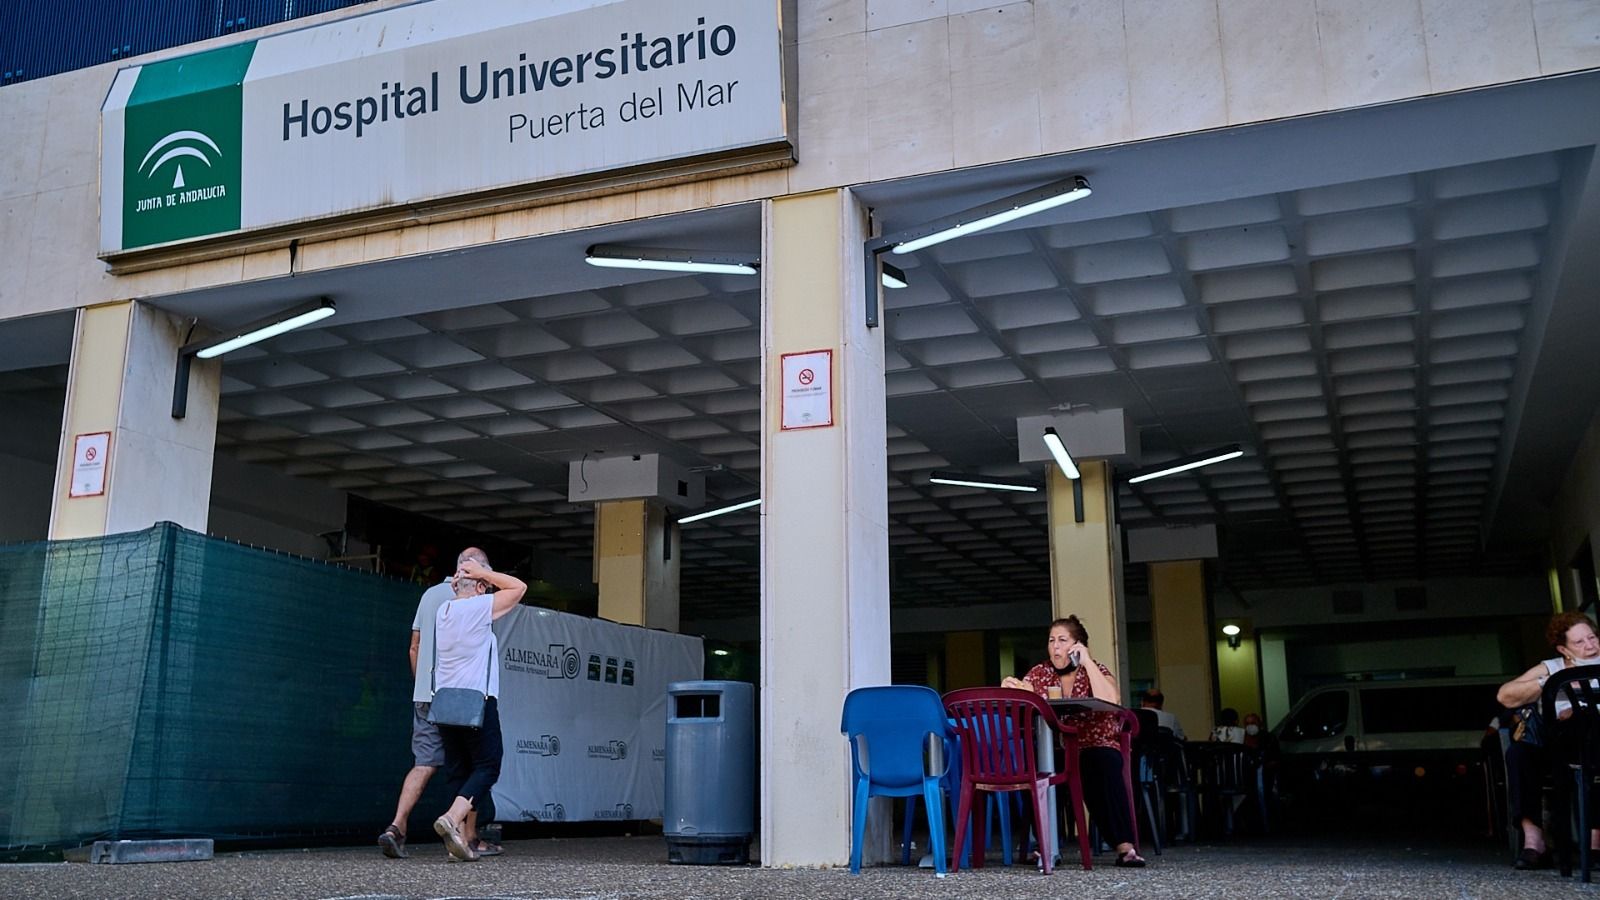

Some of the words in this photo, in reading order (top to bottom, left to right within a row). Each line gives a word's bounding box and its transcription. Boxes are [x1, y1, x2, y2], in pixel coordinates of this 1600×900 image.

[283, 72, 439, 142] Hospital
[460, 17, 736, 105] Universitario
[510, 103, 605, 144] Puerta
[620, 86, 663, 124] del
[678, 78, 738, 113] Mar
[136, 197, 162, 212] JUNTA
[166, 193, 177, 207] DE
[179, 184, 226, 204] ANDALUCIA
[505, 648, 559, 669] ALMENARA
